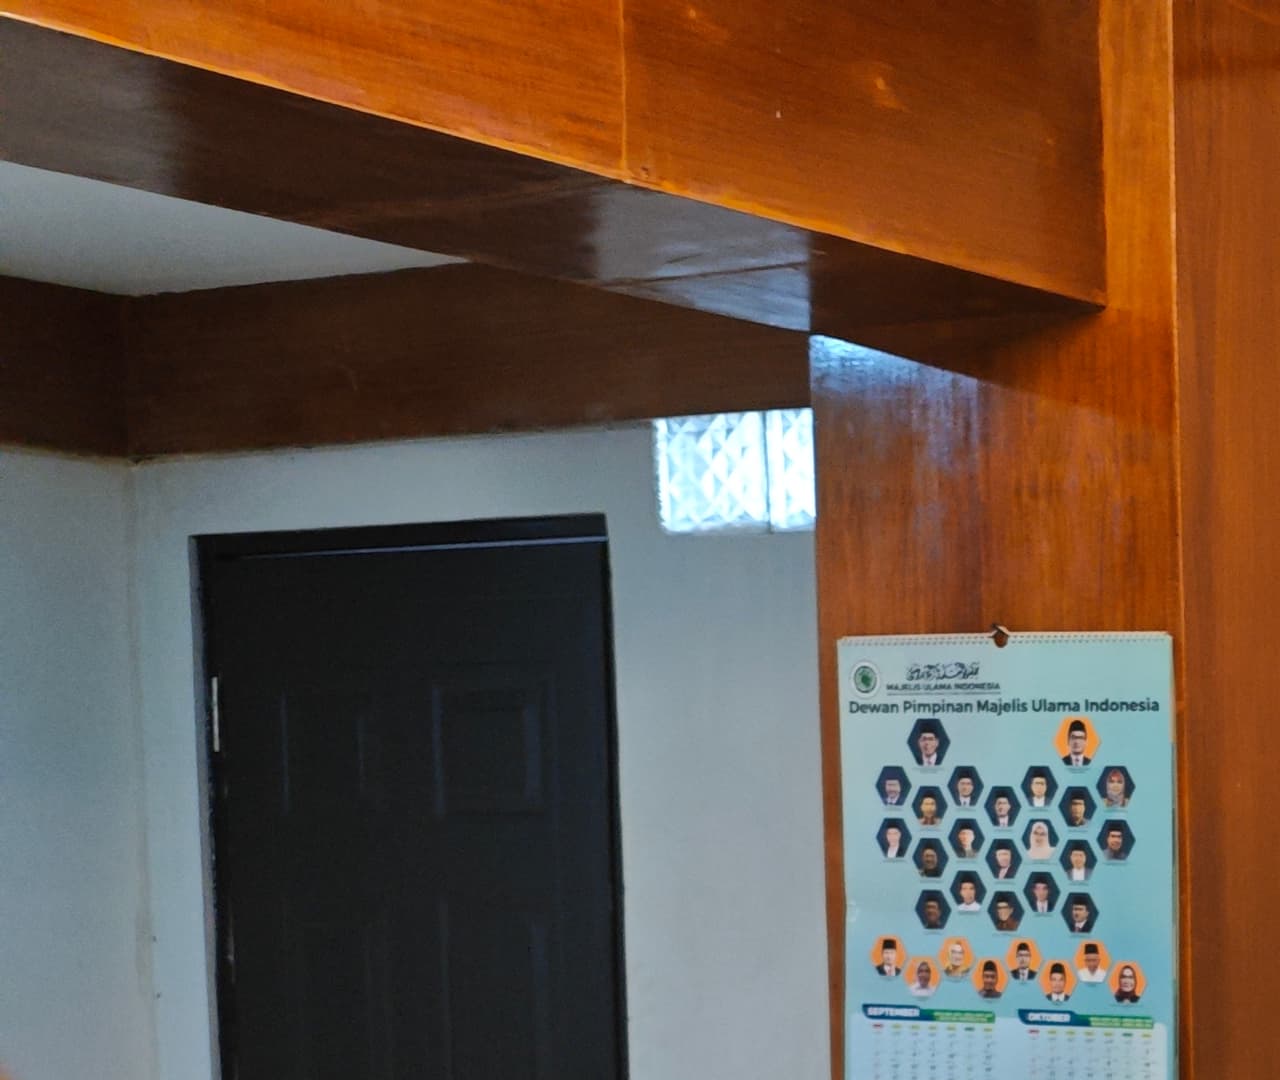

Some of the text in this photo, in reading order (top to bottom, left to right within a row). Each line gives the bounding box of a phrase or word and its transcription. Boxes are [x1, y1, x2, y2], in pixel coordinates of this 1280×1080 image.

[849, 698, 1160, 716] Dewan Pimpinan Majelis Ulama Indonesia
